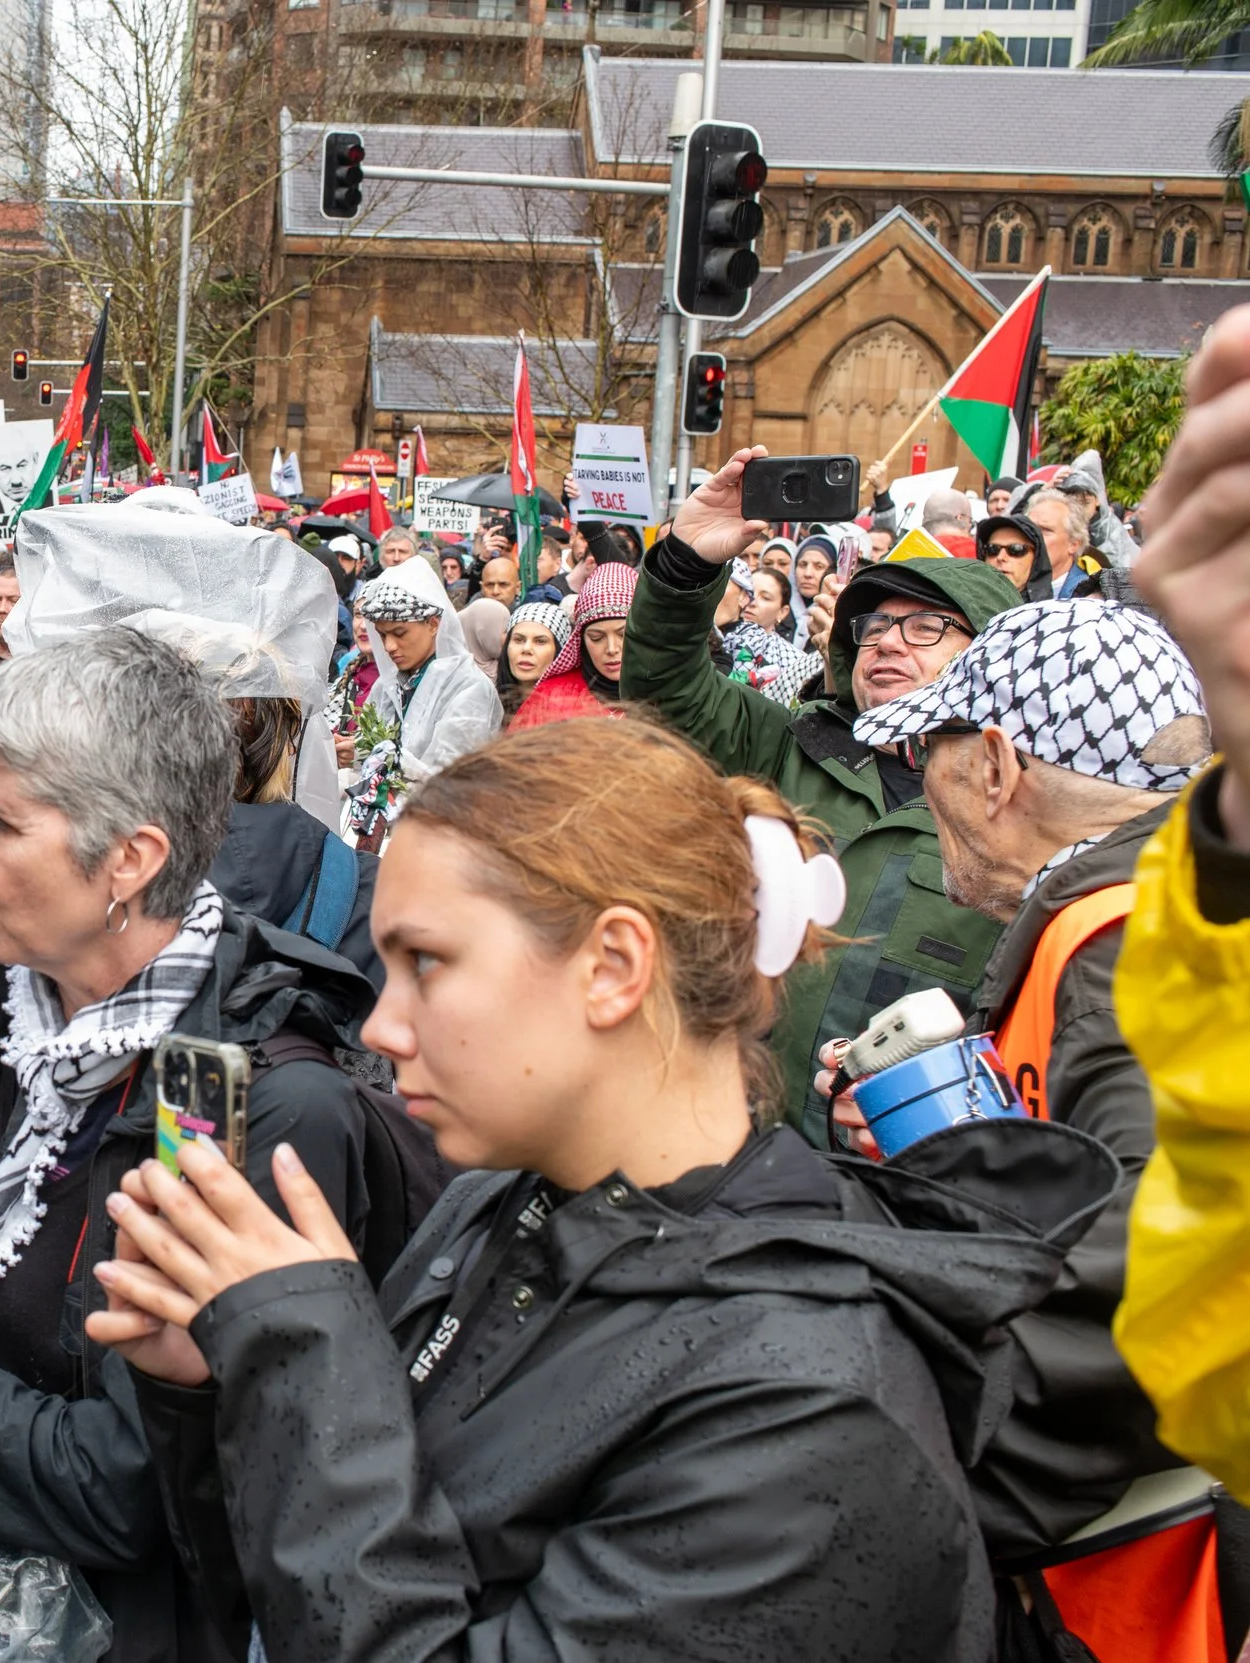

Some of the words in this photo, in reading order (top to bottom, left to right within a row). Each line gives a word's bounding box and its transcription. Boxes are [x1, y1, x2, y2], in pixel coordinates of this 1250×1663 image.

[574, 468, 600, 481] TARVING
[600, 470, 623, 482] BABIES
[625, 472, 631, 483] IS
[632, 472, 646, 483] NOT
[591, 490, 628, 511] PEACE
[420, 506, 473, 518] WEAPONS
[428, 518, 469, 531] PARTS!
[417, 1313, 461, 1370] FASS
